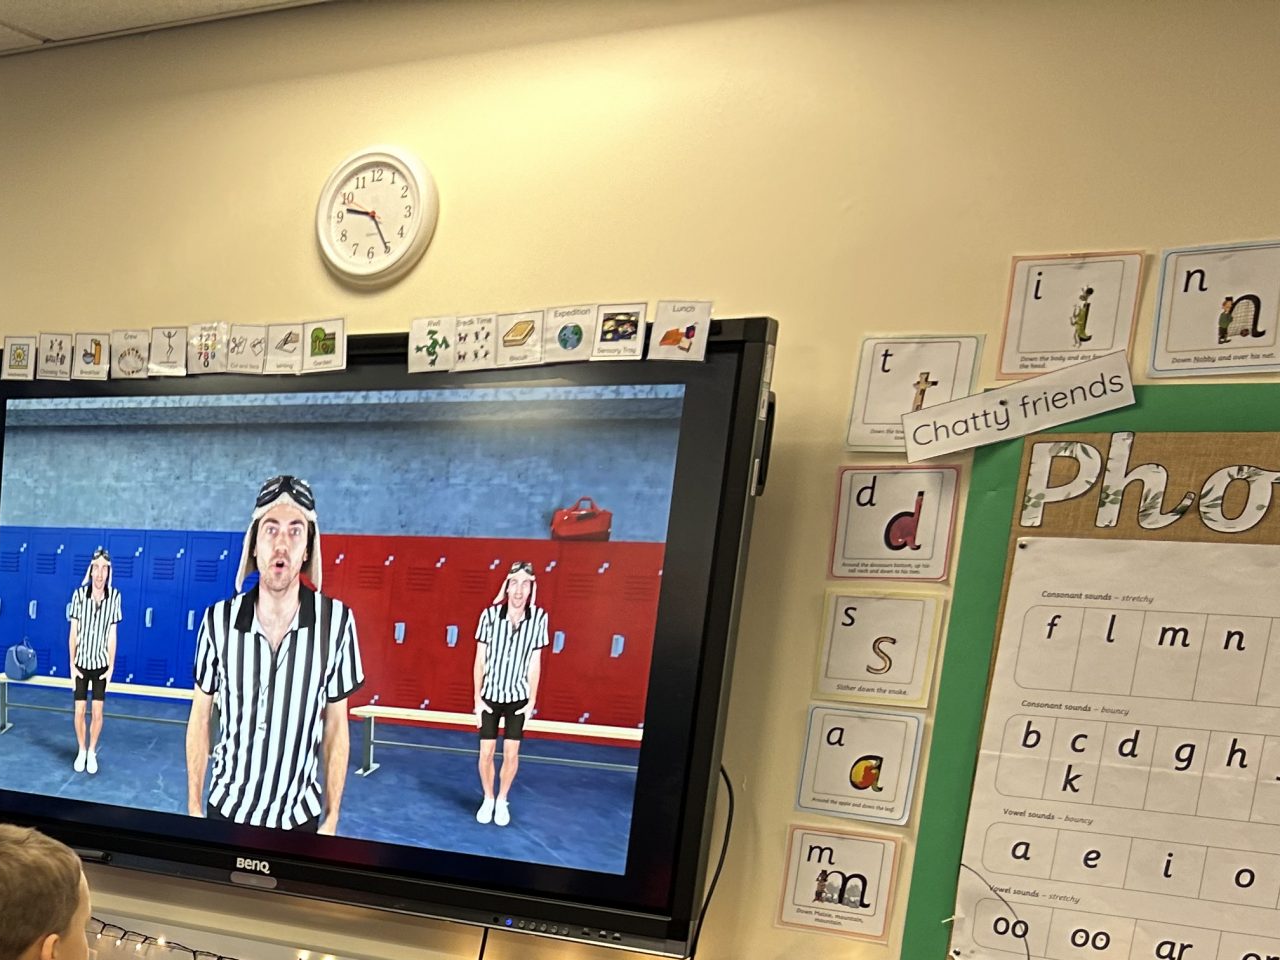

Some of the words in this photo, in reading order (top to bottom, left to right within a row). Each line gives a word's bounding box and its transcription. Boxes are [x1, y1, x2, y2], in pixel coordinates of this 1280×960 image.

[355, 176, 366, 189] 11
[371, 169, 384, 182] 12
[390, 172, 396, 184] 1
[342, 192, 354, 205] 10
[401, 185, 409, 198] 2
[337, 211, 344, 223] 9
[404, 205, 411, 218] 3
[340, 229, 347, 242] 8
[398, 225, 405, 238] 4
[352, 243, 359, 256] 7
[367, 247, 374, 259] 6
[384, 241, 391, 254] 5
[1033, 272, 1043, 299] i
[1184, 268, 1207, 292] n
[554, 308, 590, 318] Expedition
[673, 304, 695, 312] Lunch
[881, 350, 893, 372] t
[1218, 354, 1232, 362] and
[912, 408, 1010, 446] Chatty
[1019, 371, 1124, 420] friends
[856, 475, 877, 507] d
[884, 490, 925, 551] d
[1042, 591, 1083, 600] Consonant
[1084, 592, 1112, 601] sounds
[1121, 594, 1154, 605] stretchy
[841, 606, 857, 627] s
[1046, 613, 1062, 640] f
[1106, 614, 1116, 644] l
[1157, 625, 1191, 649] m
[1223, 629, 1246, 652] n
[1021, 699, 1062, 711] Consonant
[1064, 702, 1092, 713] sounds
[1101, 705, 1130, 717] bouncy
[826, 726, 845, 747] a
[1021, 720, 1042, 749] b
[1070, 732, 1088, 753] c
[1117, 729, 1140, 759] d
[1174, 742, 1197, 772] g
[1226, 738, 1248, 769] h
[1061, 765, 1083, 794] k
[1003, 808, 1027, 818] Vowel
[1028, 811, 1055, 821] sounds
[1064, 815, 1094, 826] bouncy
[806, 844, 835, 865] m
[236, 857, 271, 874] BenQ
[1011, 841, 1031, 861] a
[1082, 849, 1101, 869] e
[1163, 852, 1174, 879] i
[1234, 868, 1256, 889] o
[989, 884, 1011, 895] Vowel
[1012, 888, 1040, 899] sounds
[1048, 893, 1080, 905] stretchy
[992, 916, 1029, 939] oo
[1070, 928, 1111, 951] oo
